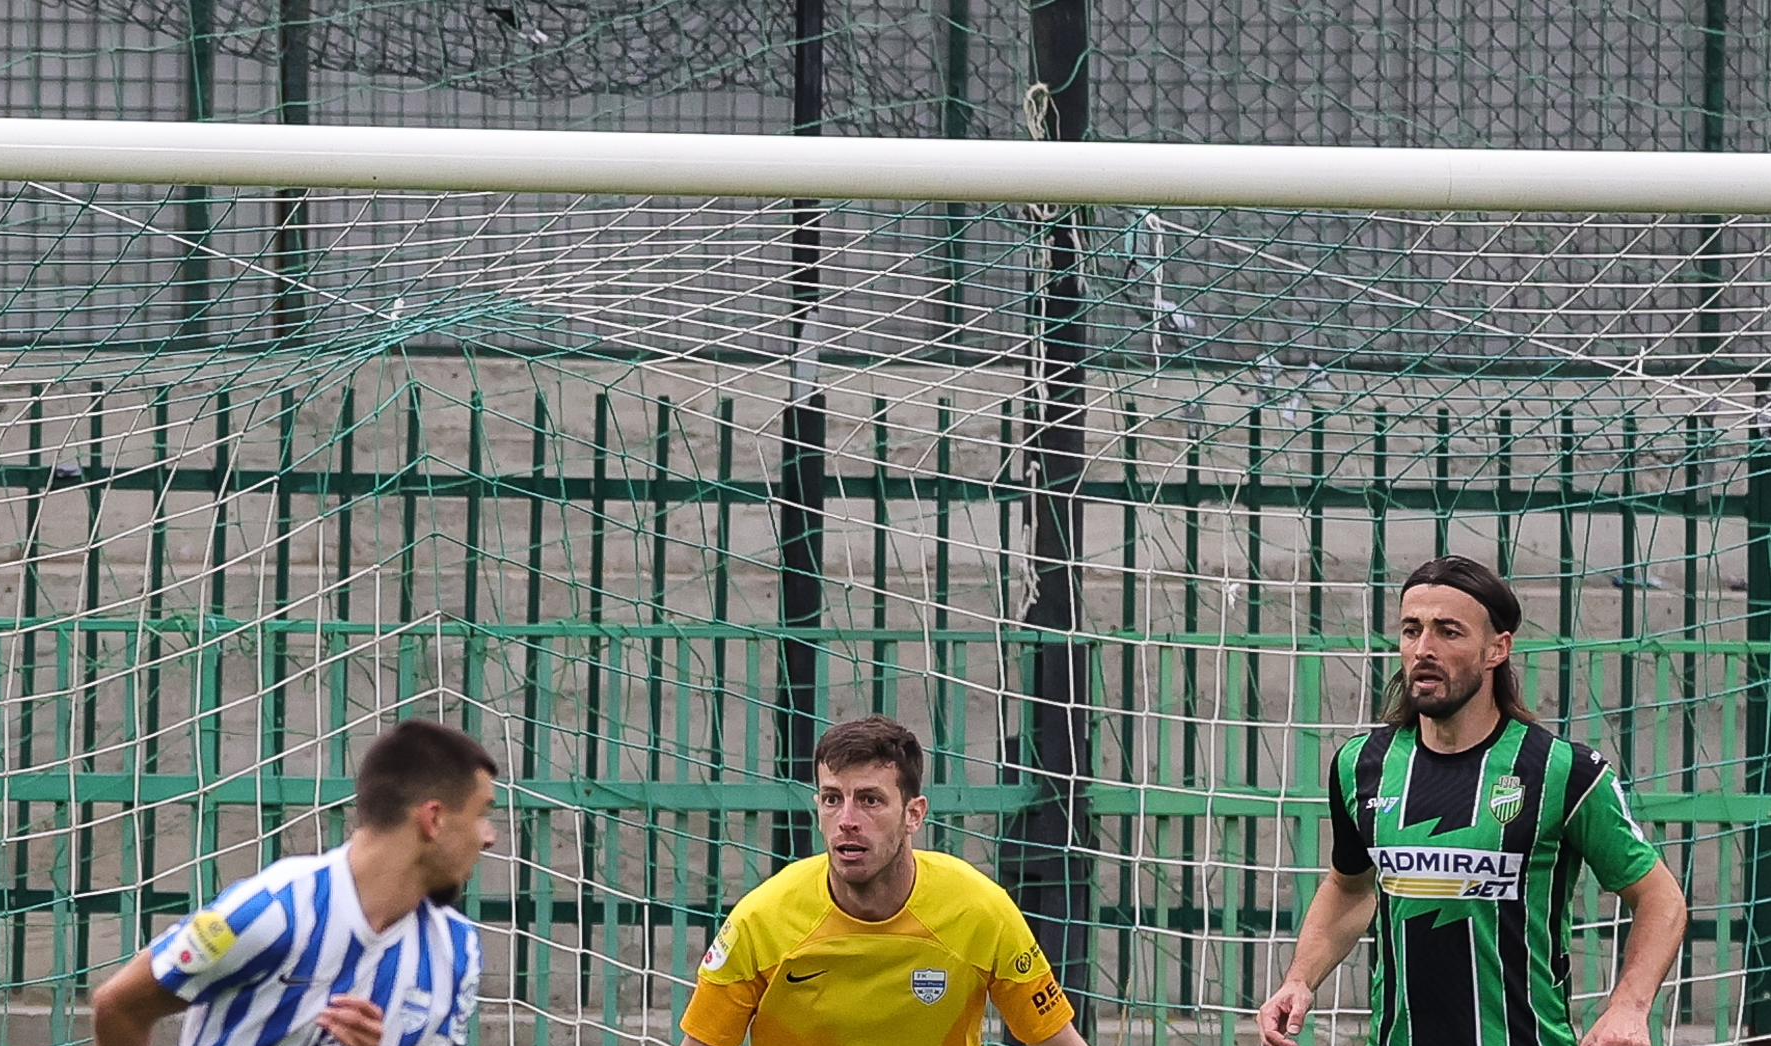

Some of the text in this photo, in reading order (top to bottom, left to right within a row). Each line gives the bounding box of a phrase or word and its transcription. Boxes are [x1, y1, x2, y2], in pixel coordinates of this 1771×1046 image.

[1378, 849, 1518, 878] ADMIRAL
[1462, 880, 1516, 898] BET
[1031, 981, 1060, 1009] DE
